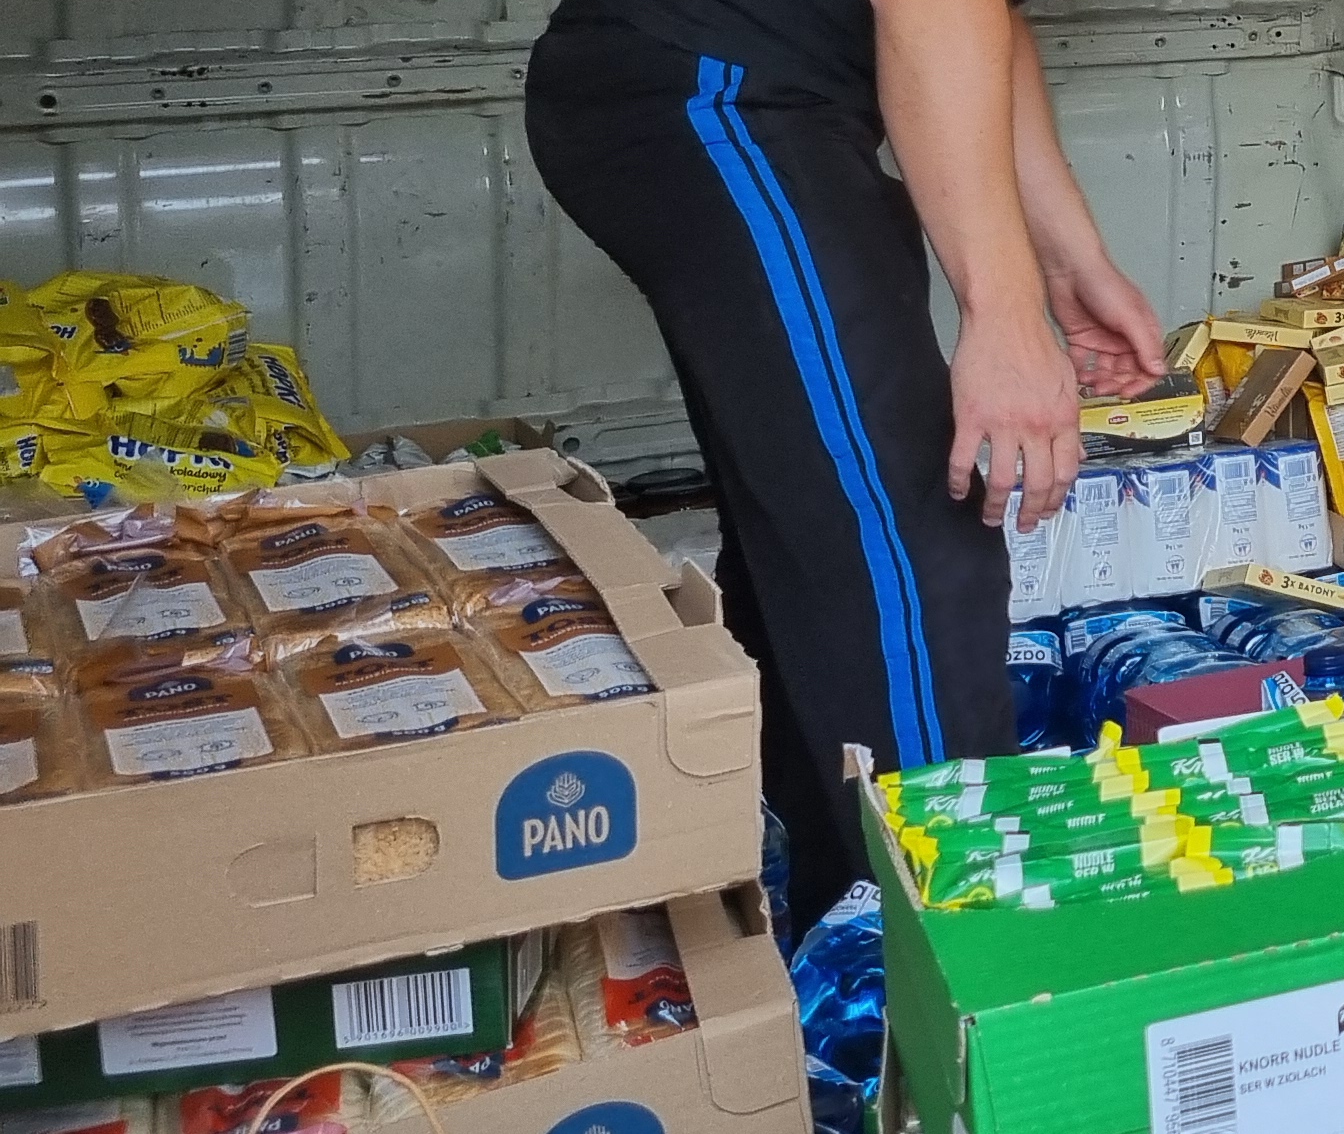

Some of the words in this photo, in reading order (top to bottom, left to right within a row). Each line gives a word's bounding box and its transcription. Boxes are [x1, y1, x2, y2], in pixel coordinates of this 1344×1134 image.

[453, 499, 495, 516] PANO
[274, 528, 318, 547] PANO
[1281, 575, 1296, 589] 3x
[1298, 581, 1337, 599] BATONY
[536, 603, 584, 617] PANO
[145, 683, 197, 699] PANO
[523, 805, 610, 857] PANO
[1238, 1049, 1290, 1076] KNORR
[1293, 1038, 1343, 1063] NUDLE
[1239, 1079, 1263, 1096] SER
[1264, 1075, 1277, 1089] W
